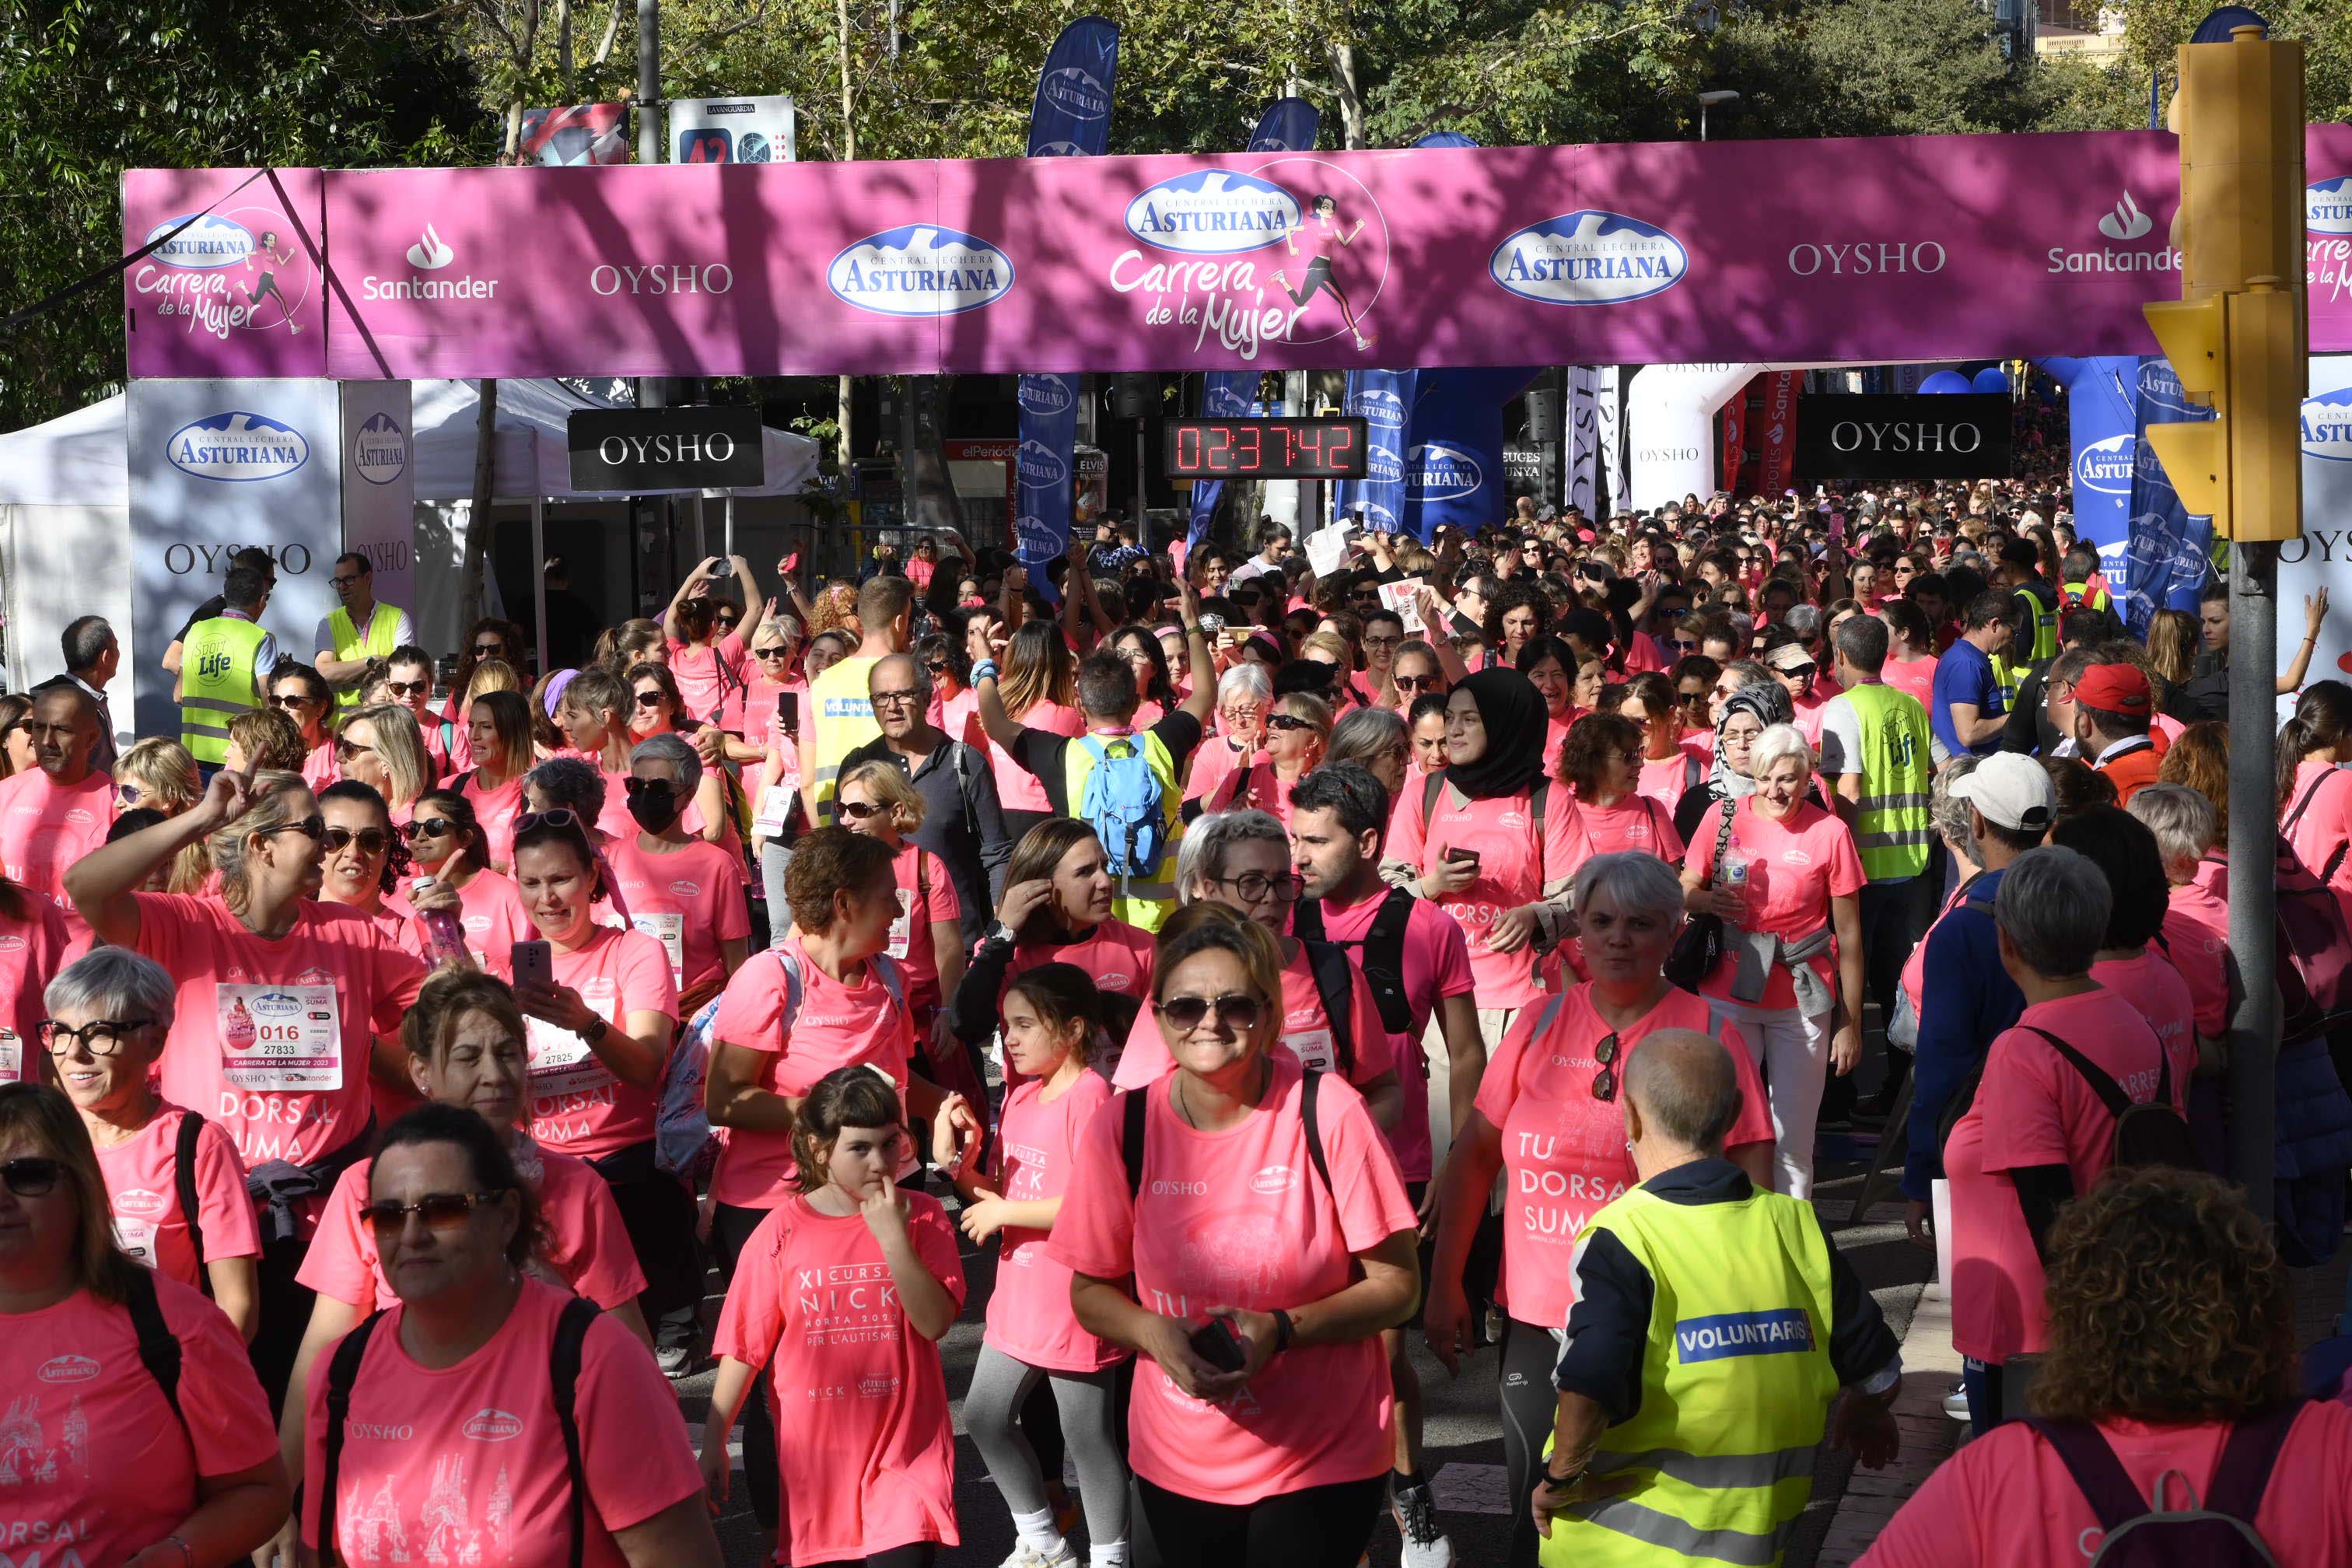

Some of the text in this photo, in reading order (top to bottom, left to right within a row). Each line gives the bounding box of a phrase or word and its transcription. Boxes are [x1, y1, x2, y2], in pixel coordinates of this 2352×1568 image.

[715, 105, 754, 114] VANGUARDIA
[1165, 198, 1283, 208] CENTRAL LECHERA
[1139, 201, 1288, 233] ASTURIANA
[153, 234, 247, 255] ASTURIANA
[1535, 242, 1666, 254] CENTRAL LECHERA
[870, 254, 929, 264] CENTRAL
[1504, 247, 1672, 282] ASTURIANA
[1789, 241, 1946, 275] OYSHO
[2048, 246, 2183, 274] Santande
[135, 264, 226, 294] Carrera
[590, 263, 733, 296] OYSHO
[842, 259, 1000, 293] ASTURIANA
[1110, 249, 1256, 294] Carrera
[363, 275, 499, 300] Santander
[158, 291, 261, 340] de la Mujer
[1146, 286, 1310, 361] de la Mujer
[1772, 369, 1792, 421] Santa
[1348, 400, 1403, 424] ASTURIAN
[599, 432, 736, 465] OYSHO
[1177, 425, 1353, 470] 02:37:42
[1572, 365, 1597, 516] OYSH
[1831, 421, 1982, 453] OYSHO
[177, 438, 299, 464] ASTURIANA
[359, 443, 405, 467] ASTURIANA
[963, 444, 1018, 458] elPeriódi
[1640, 446, 1699, 463] OYSHO
[1080, 460, 1104, 471] ELVIS
[164, 542, 312, 575] OYO
[194, 638, 229, 658] Sport
[199, 652, 231, 678] Life
[825, 702, 873, 713] VOLUNTA
[1881, 712, 1910, 744] Sport
[1889, 731, 1918, 768] Life
[1441, 813, 1473, 822] OYSHO
[5, 864, 23, 883] TU
[254, 1000, 299, 1013] ASTURIANA
[806, 1014, 850, 1026] OYSHO
[259, 1025, 299, 1041] 016
[264, 1044, 295, 1055] 27833
[545, 1052, 573, 1064] 27825
[1300, 1044, 1323, 1053] SUMA
[233, 1059, 265, 1068] CARRERA
[289, 1059, 311, 1067] MUJER
[1551, 1054, 1597, 1069] OYSHO
[232, 1074, 266, 1084] OYSHO
[219, 1090, 332, 1125] DORSAL
[534, 1086, 620, 1118] ORSAL
[534, 1118, 592, 1141] UMA
[1518, 1132, 1557, 1160] TU
[1152, 1180, 1208, 1195] OYSHO
[1520, 1168, 1626, 1202] DORSA
[1524, 1205, 1585, 1235] SUM
[800, 1269, 822, 1290] XI
[800, 1286, 898, 1314] NICK
[1150, 1287, 1187, 1318] TU
[805, 1314, 898, 1328] HORTA 2022
[807, 1328, 899, 1346] PER L'AUTISME
[1679, 1320, 1807, 1353] VOLUNTARIS
[808, 1386, 845, 1398] NICK
[351, 1423, 413, 1440] OYSHO
